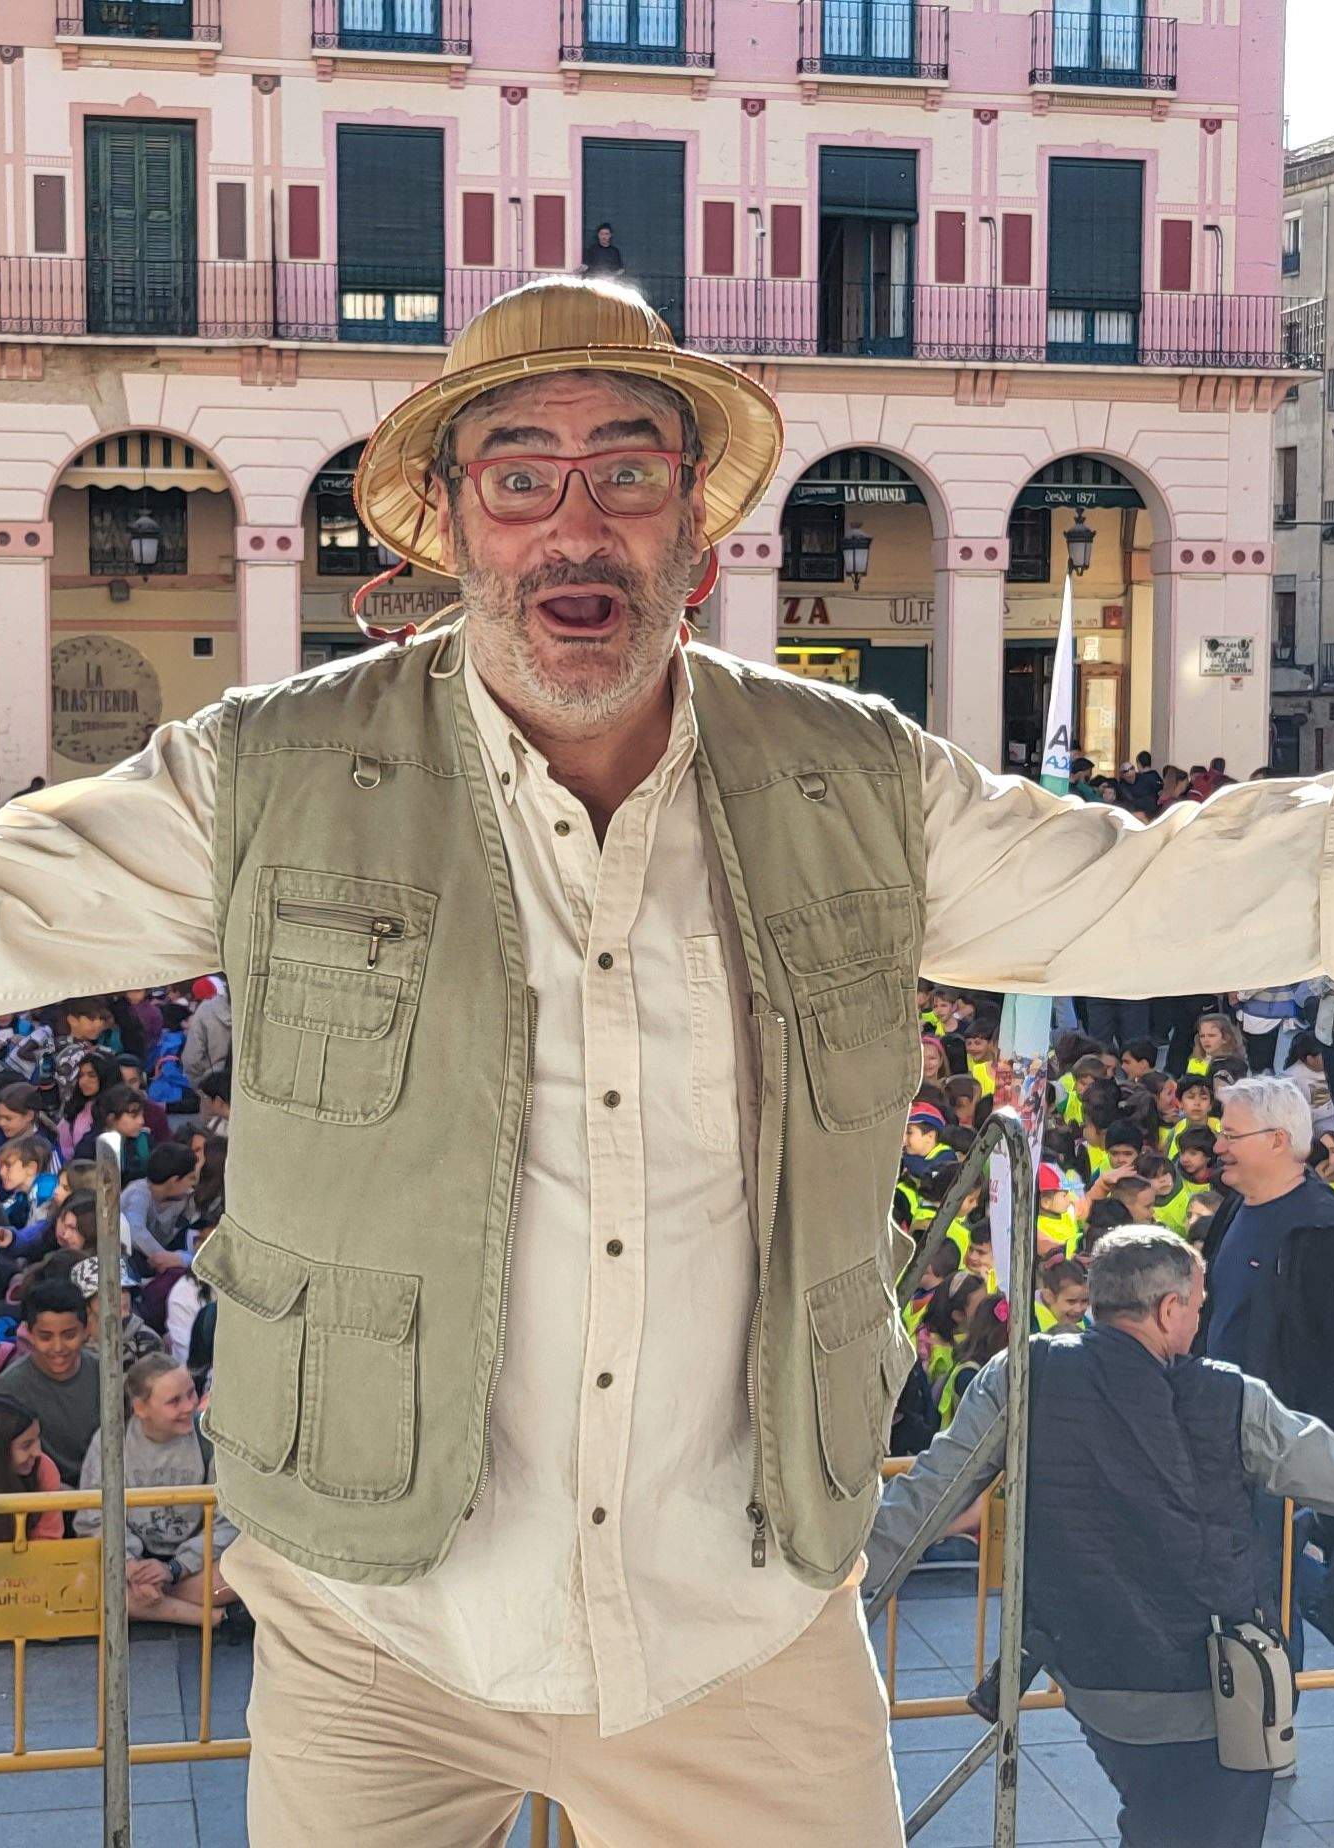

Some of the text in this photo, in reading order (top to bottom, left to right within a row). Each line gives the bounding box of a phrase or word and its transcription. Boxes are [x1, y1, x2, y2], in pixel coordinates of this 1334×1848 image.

[844, 486, 856, 502] LA
[858, 486, 906, 502] CONFIANZA
[1045, 489, 1096, 505] desde 1871
[86, 662, 104, 688] LA
[52, 686, 139, 713] TRASTIENDA
